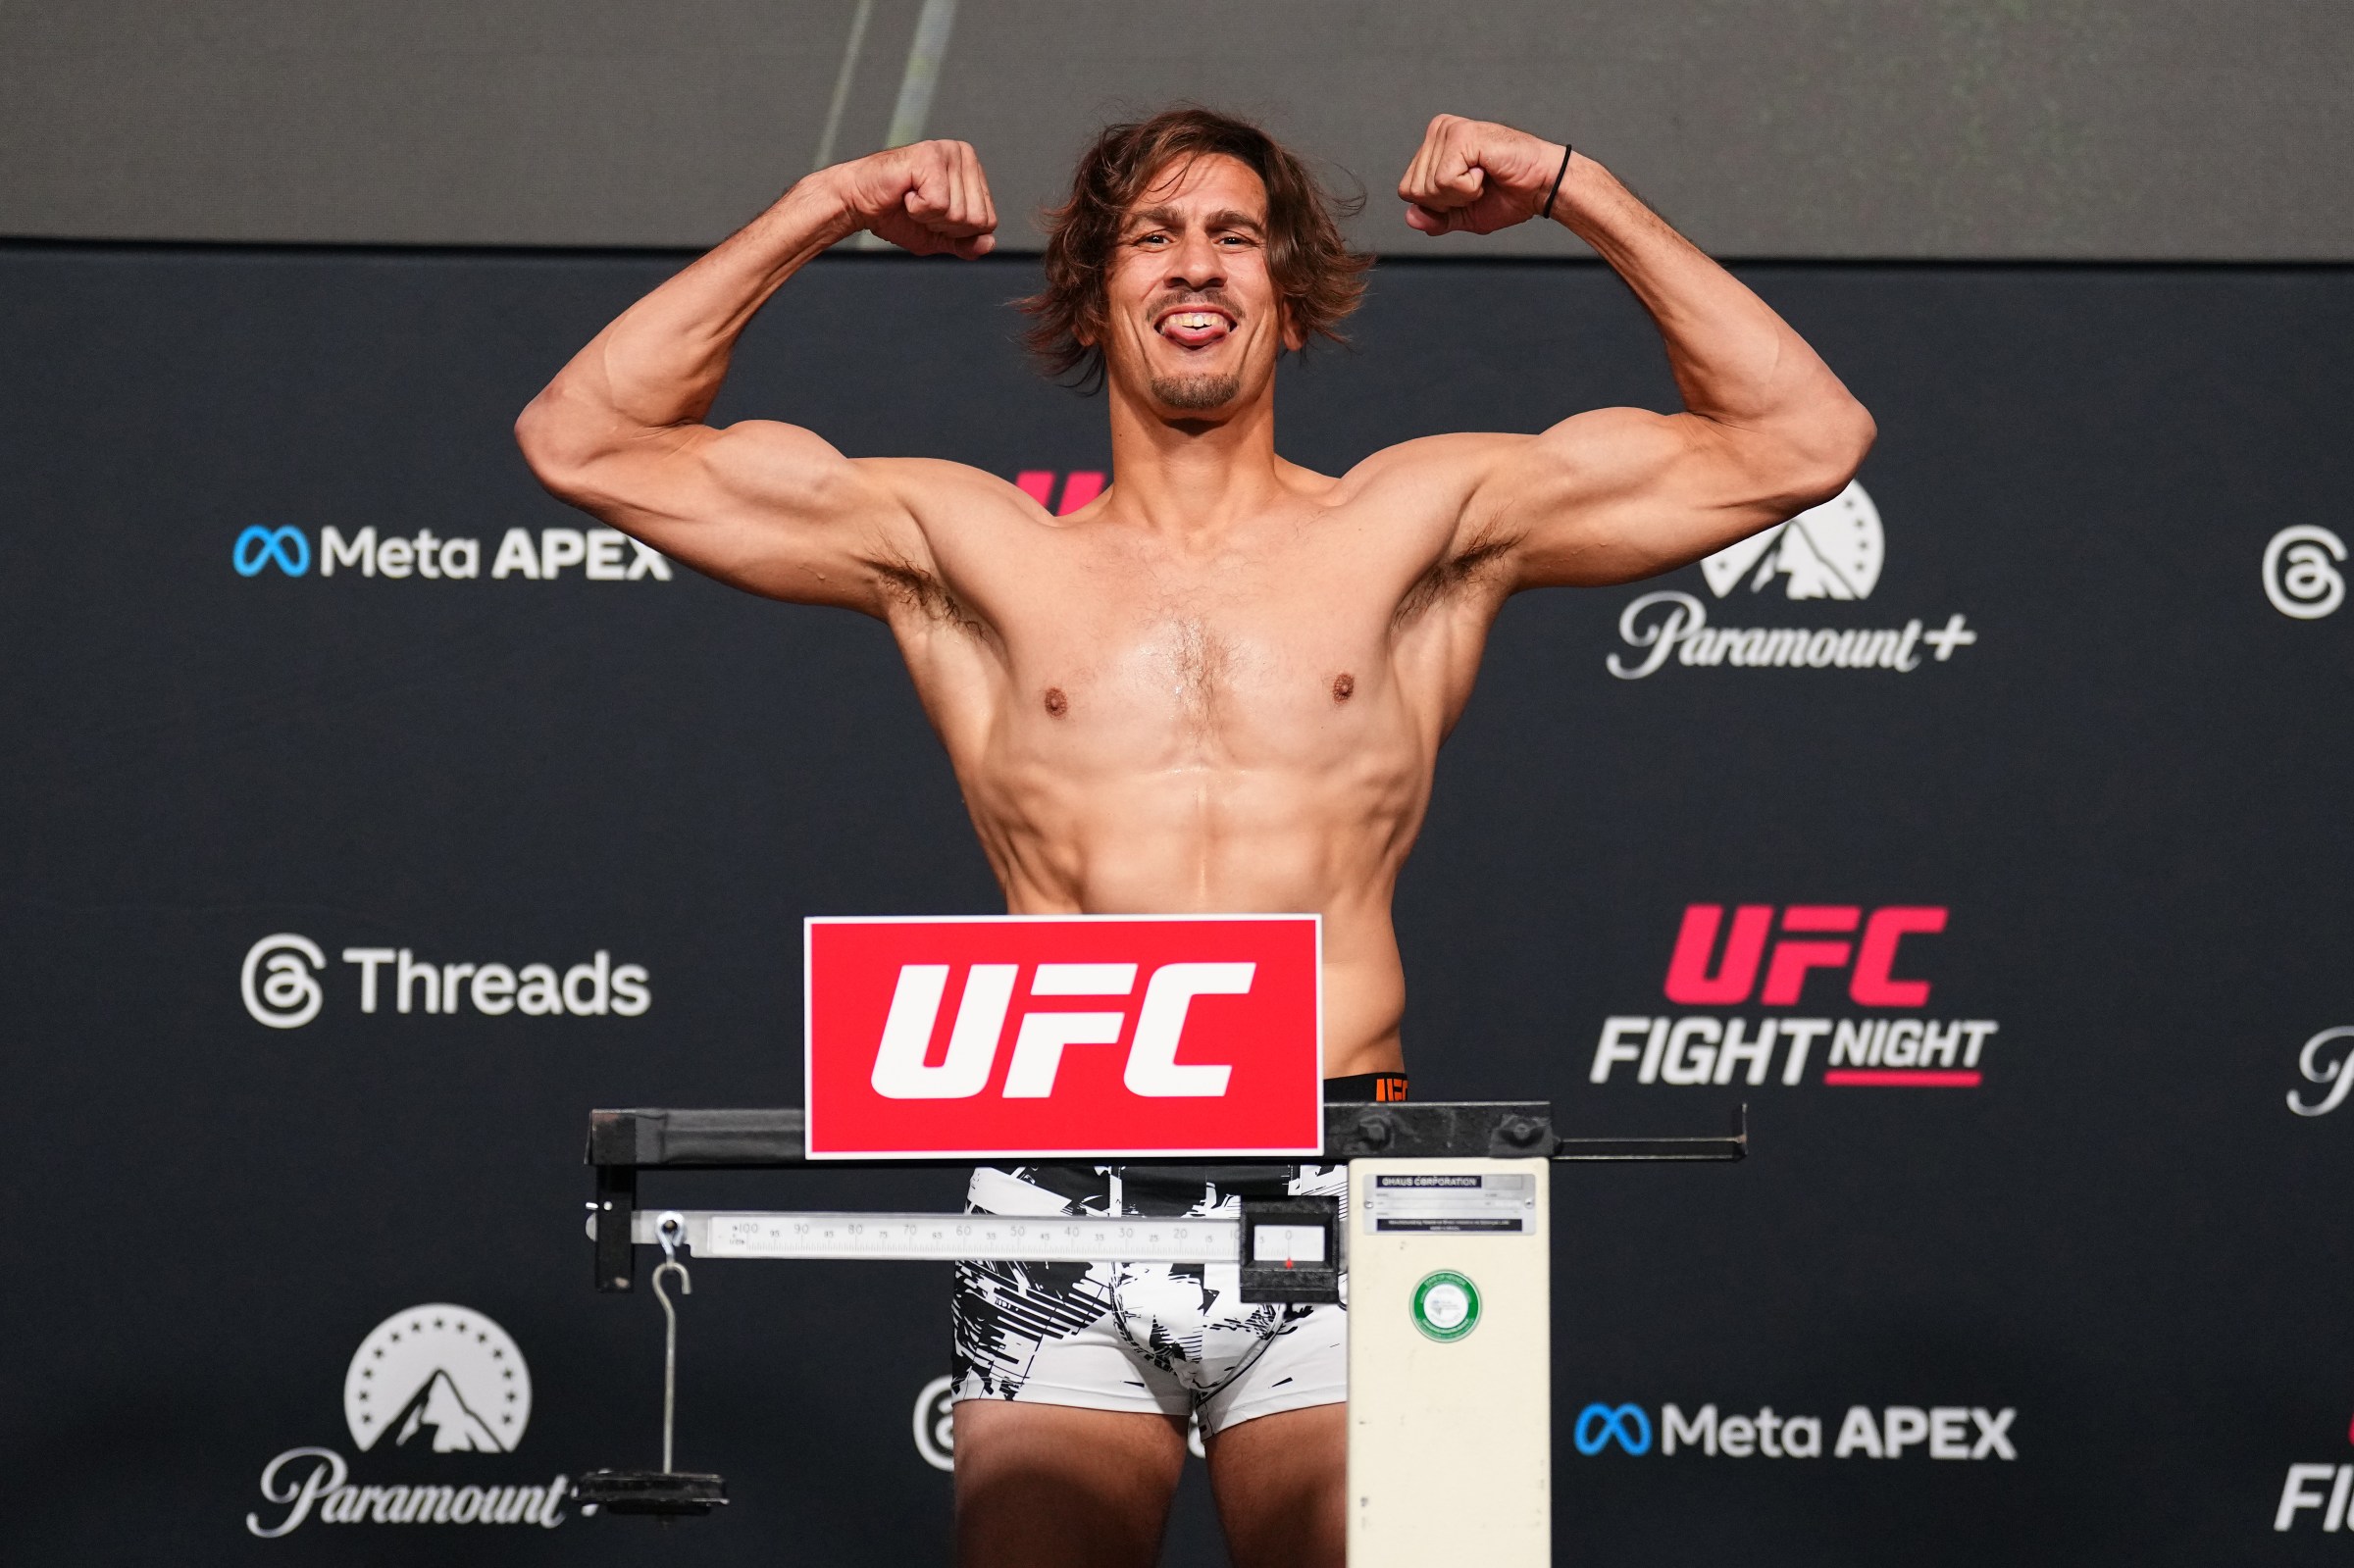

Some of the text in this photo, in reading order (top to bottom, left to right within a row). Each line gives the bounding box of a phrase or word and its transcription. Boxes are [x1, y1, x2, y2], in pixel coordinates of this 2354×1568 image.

[320, 525, 481, 580] Meta
[1606, 590, 1977, 680] Paramount+
[342, 947, 651, 1016] Threads
[1663, 903, 1950, 1007] UFC
[871, 962, 1256, 1099] UFC
[1589, 1016, 1999, 1086] FIGHT NIGHT
[1414, 1177, 1476, 1187] CORPORATION
[739, 1224, 759, 1234] 100
[793, 1224, 809, 1235] 90
[847, 1224, 863, 1235] 80
[903, 1224, 917, 1235] 70
[955, 1225, 971, 1236] 60
[1010, 1225, 1025, 1237] 50
[1063, 1226, 1080, 1238] 40
[1118, 1227, 1134, 1239] 30
[1173, 1228, 1188, 1239] 20
[1285, 1230, 1293, 1240] 0
[1662, 1402, 2018, 1460] Meta APEX
[246, 1446, 597, 1538] Paramount
[2274, 1462, 2354, 1533] FI
